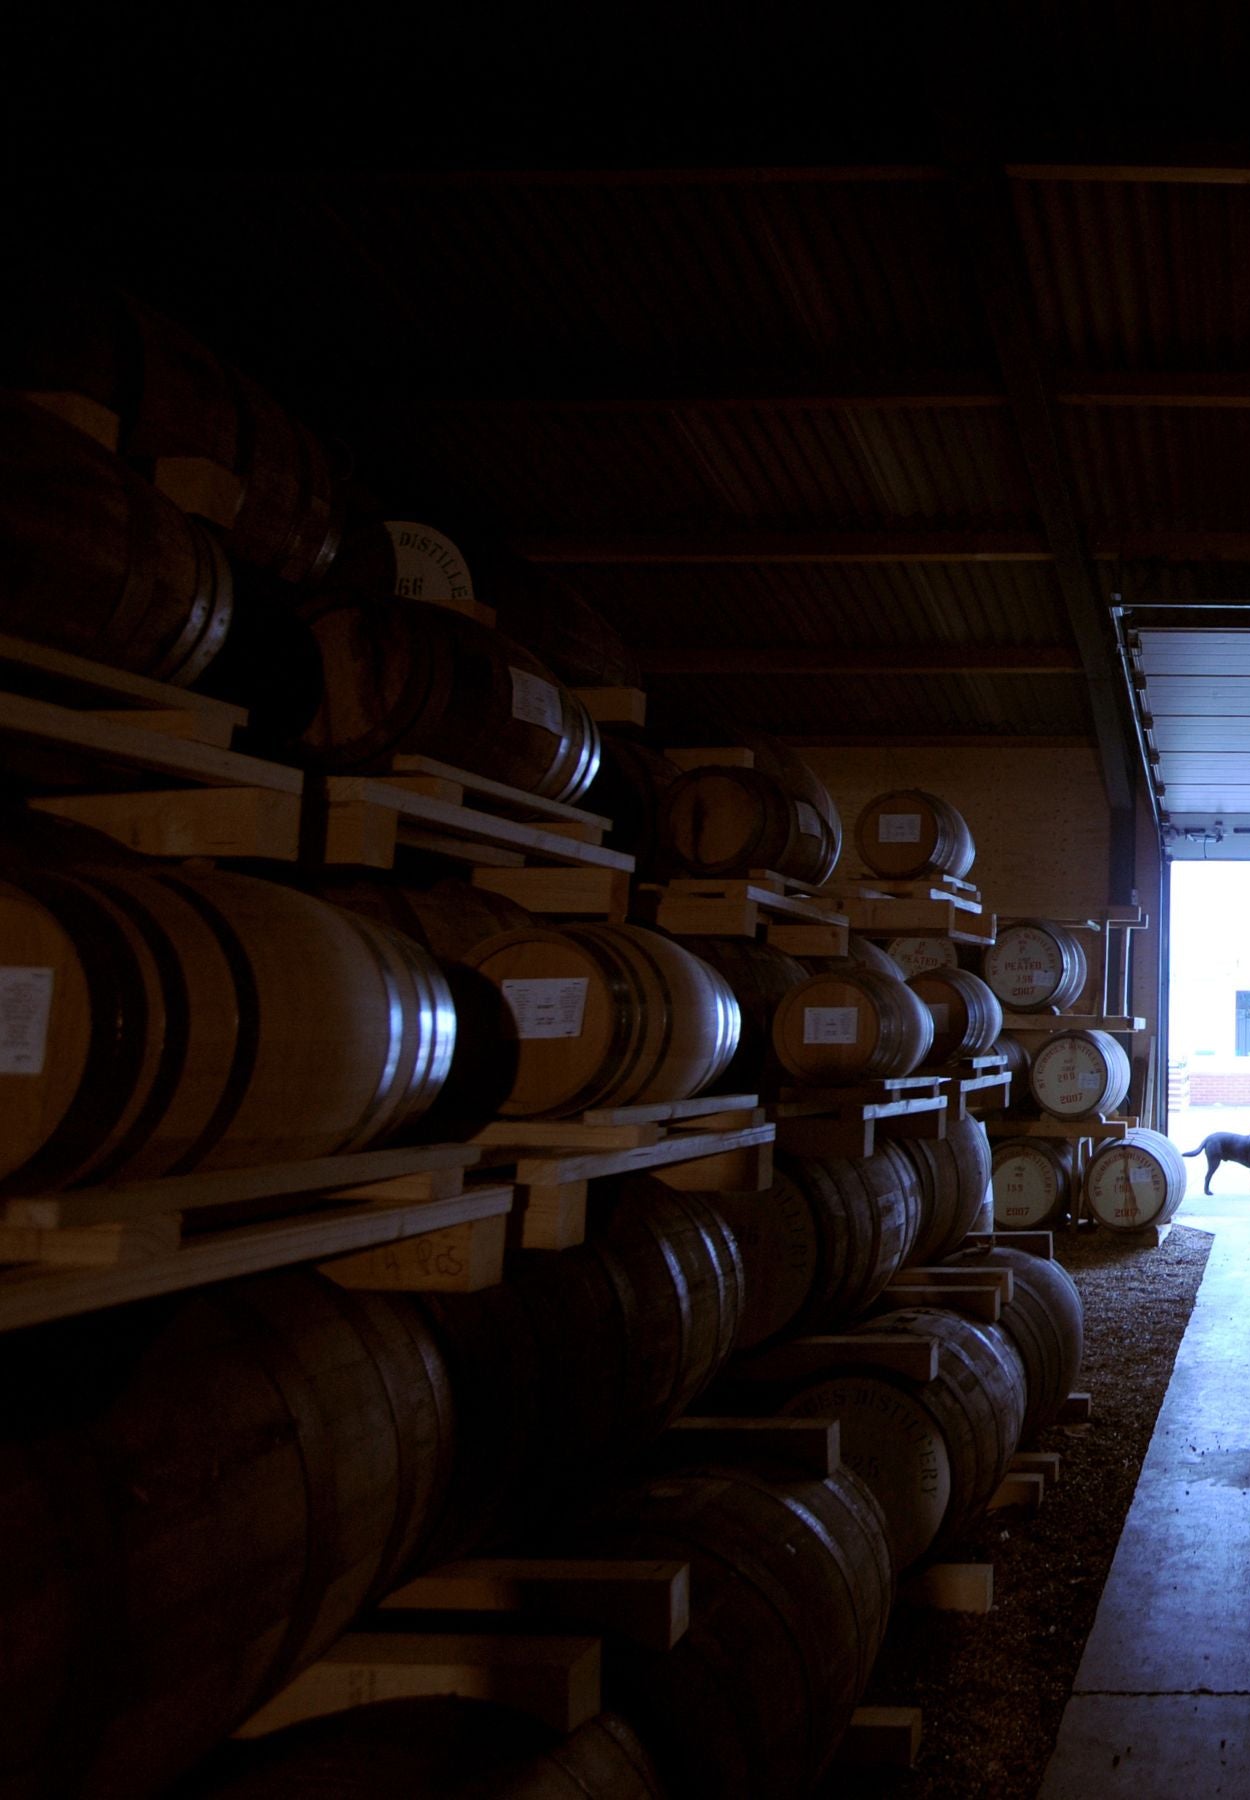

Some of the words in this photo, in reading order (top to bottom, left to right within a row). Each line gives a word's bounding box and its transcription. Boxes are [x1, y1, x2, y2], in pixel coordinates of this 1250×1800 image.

[1004, 960, 1042, 971] PEATED
[1012, 987, 1036, 997] 2007
[1060, 1092, 1083, 1104] 2007
[1006, 1207, 1030, 1216] 2007
